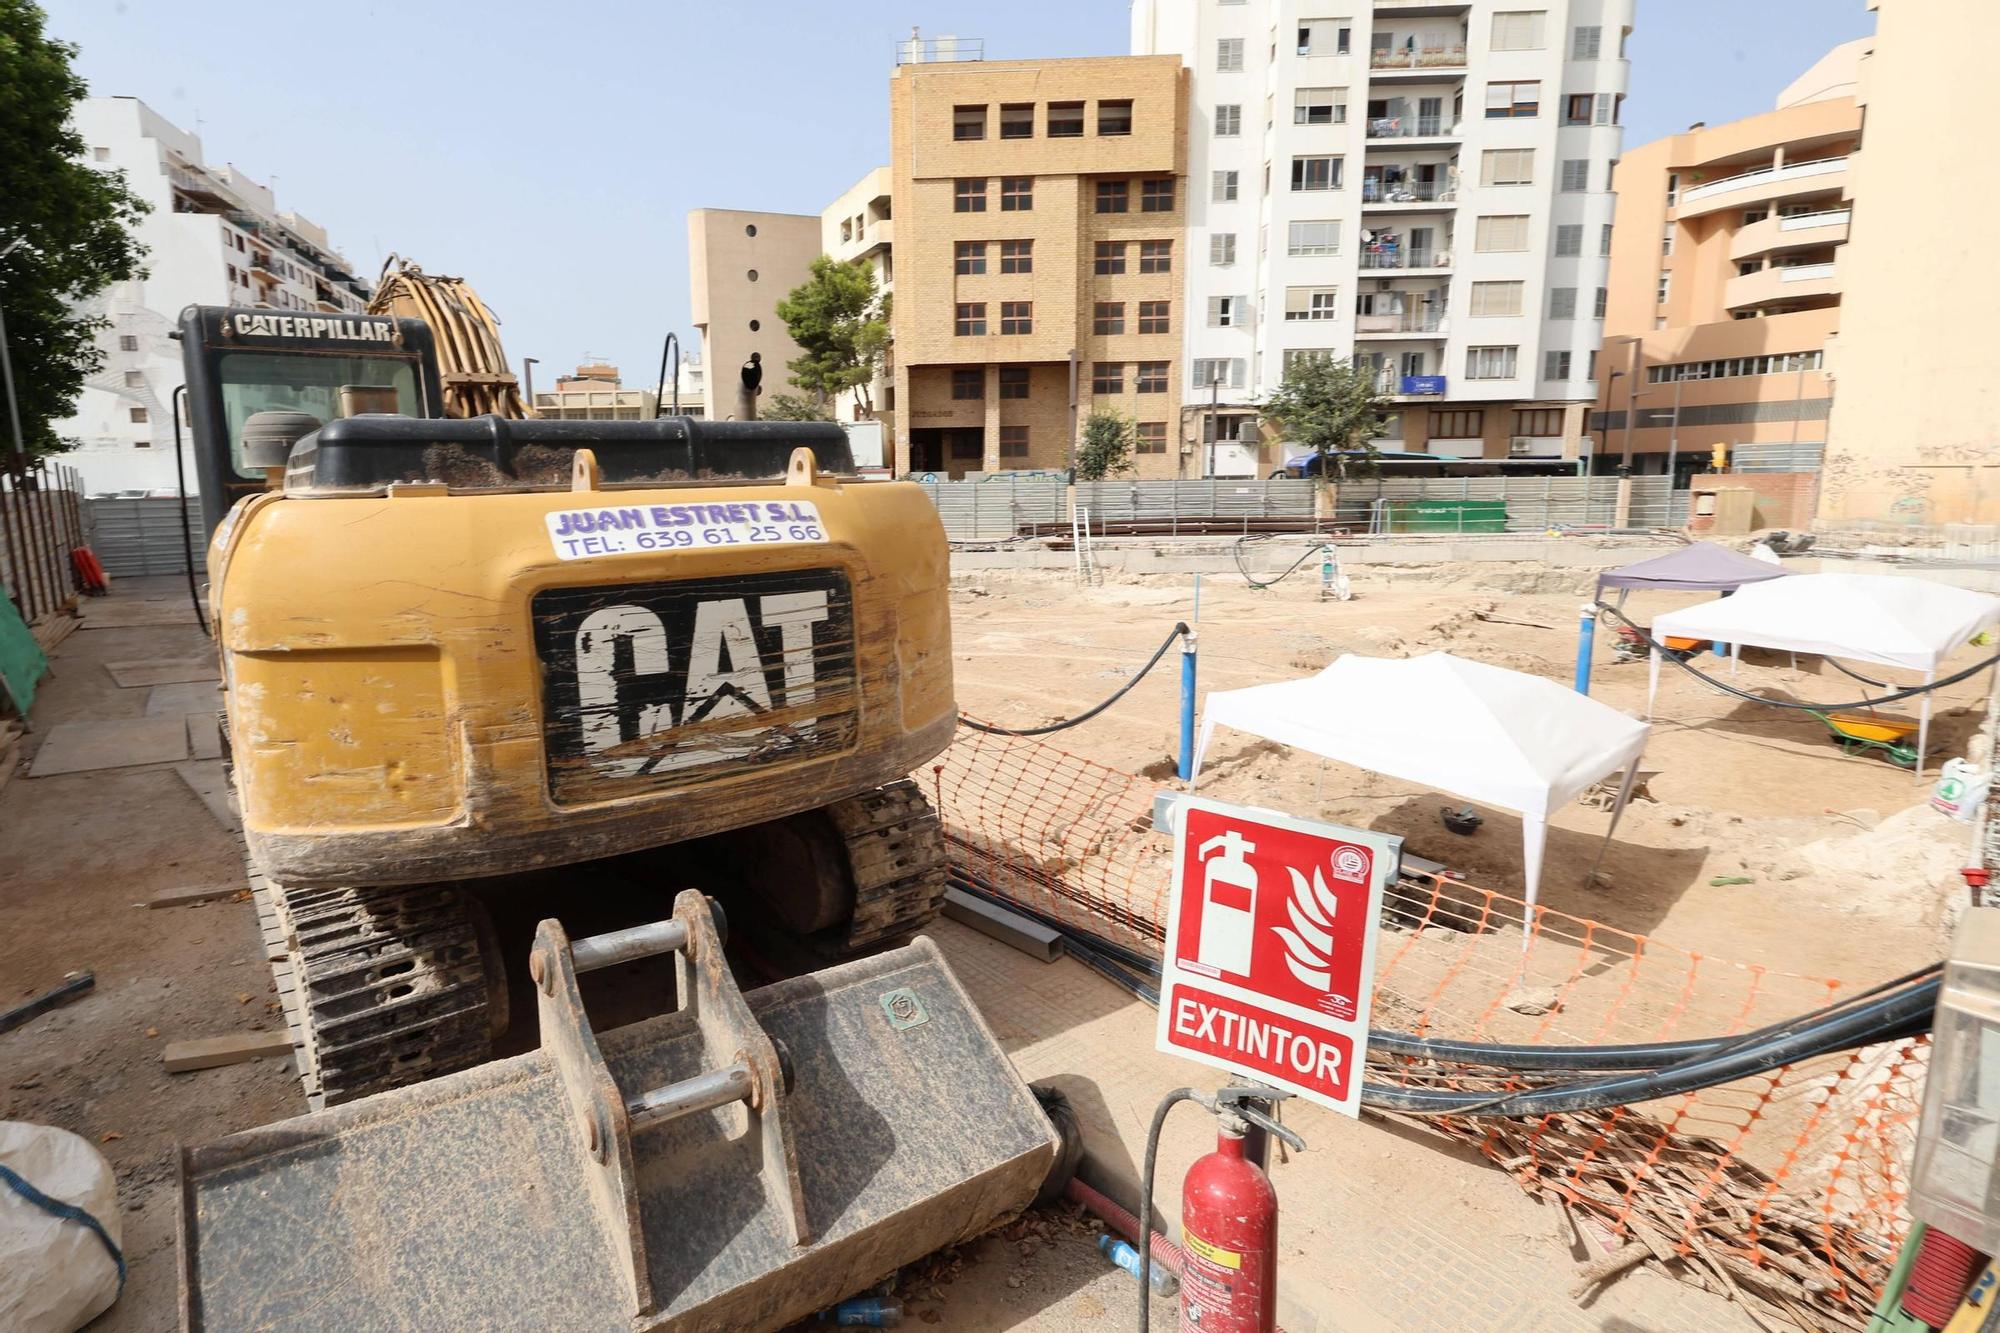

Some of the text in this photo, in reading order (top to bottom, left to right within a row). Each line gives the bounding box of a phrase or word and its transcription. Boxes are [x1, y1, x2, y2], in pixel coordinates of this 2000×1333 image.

[235, 313, 391, 342] CATERPILLAR
[556, 503, 816, 536] JUAN ESTRET S.L.
[562, 525, 822, 556] TEL: 639 61 25 66
[575, 590, 829, 778] CAT
[1175, 997, 1342, 1086] EXTINTOR
